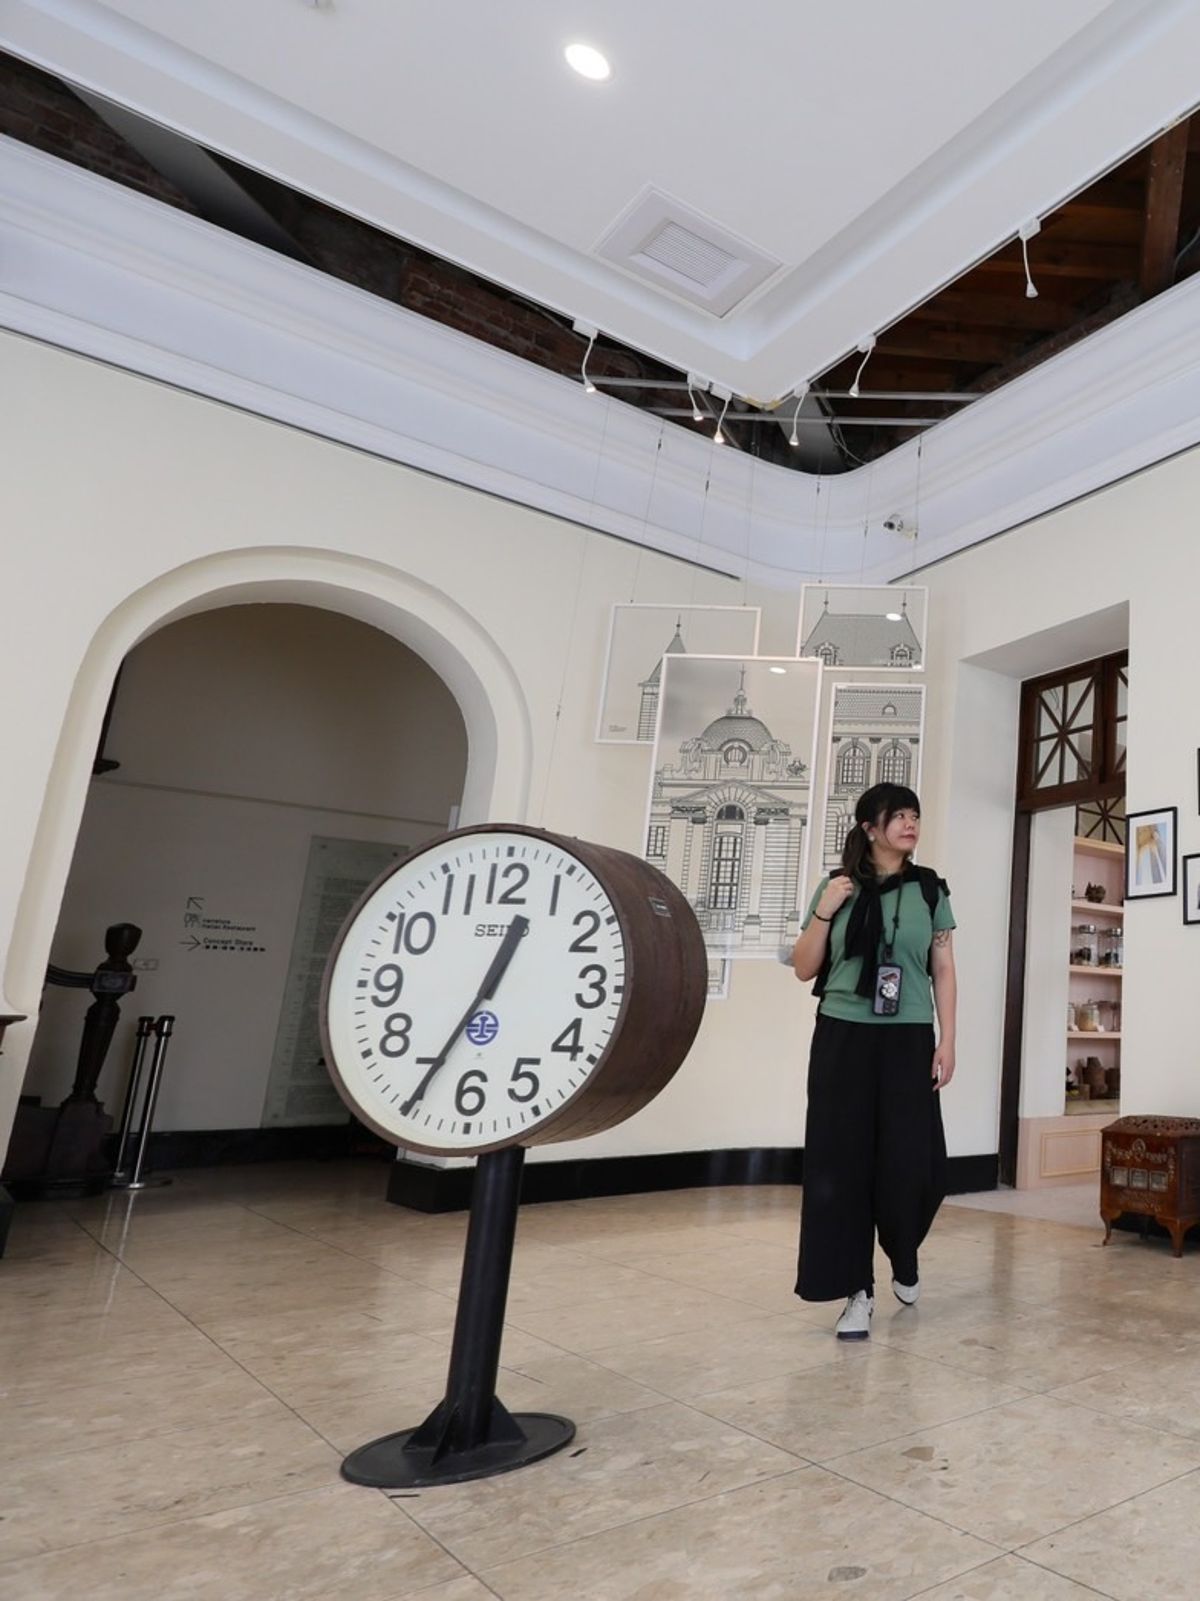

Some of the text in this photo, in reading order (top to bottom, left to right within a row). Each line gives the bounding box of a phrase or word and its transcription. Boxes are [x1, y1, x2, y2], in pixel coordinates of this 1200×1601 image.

[442, 874, 476, 916] 11
[486, 863, 530, 905] 12
[549, 874, 562, 917] 1
[393, 911, 436, 955] 10
[569, 910, 601, 953] 2
[371, 964, 404, 1008] 9
[575, 964, 608, 1009] 3
[379, 1012, 413, 1058] 8
[551, 1017, 584, 1062] 4
[455, 1069, 488, 1117] 6
[507, 1058, 541, 1103] 5
